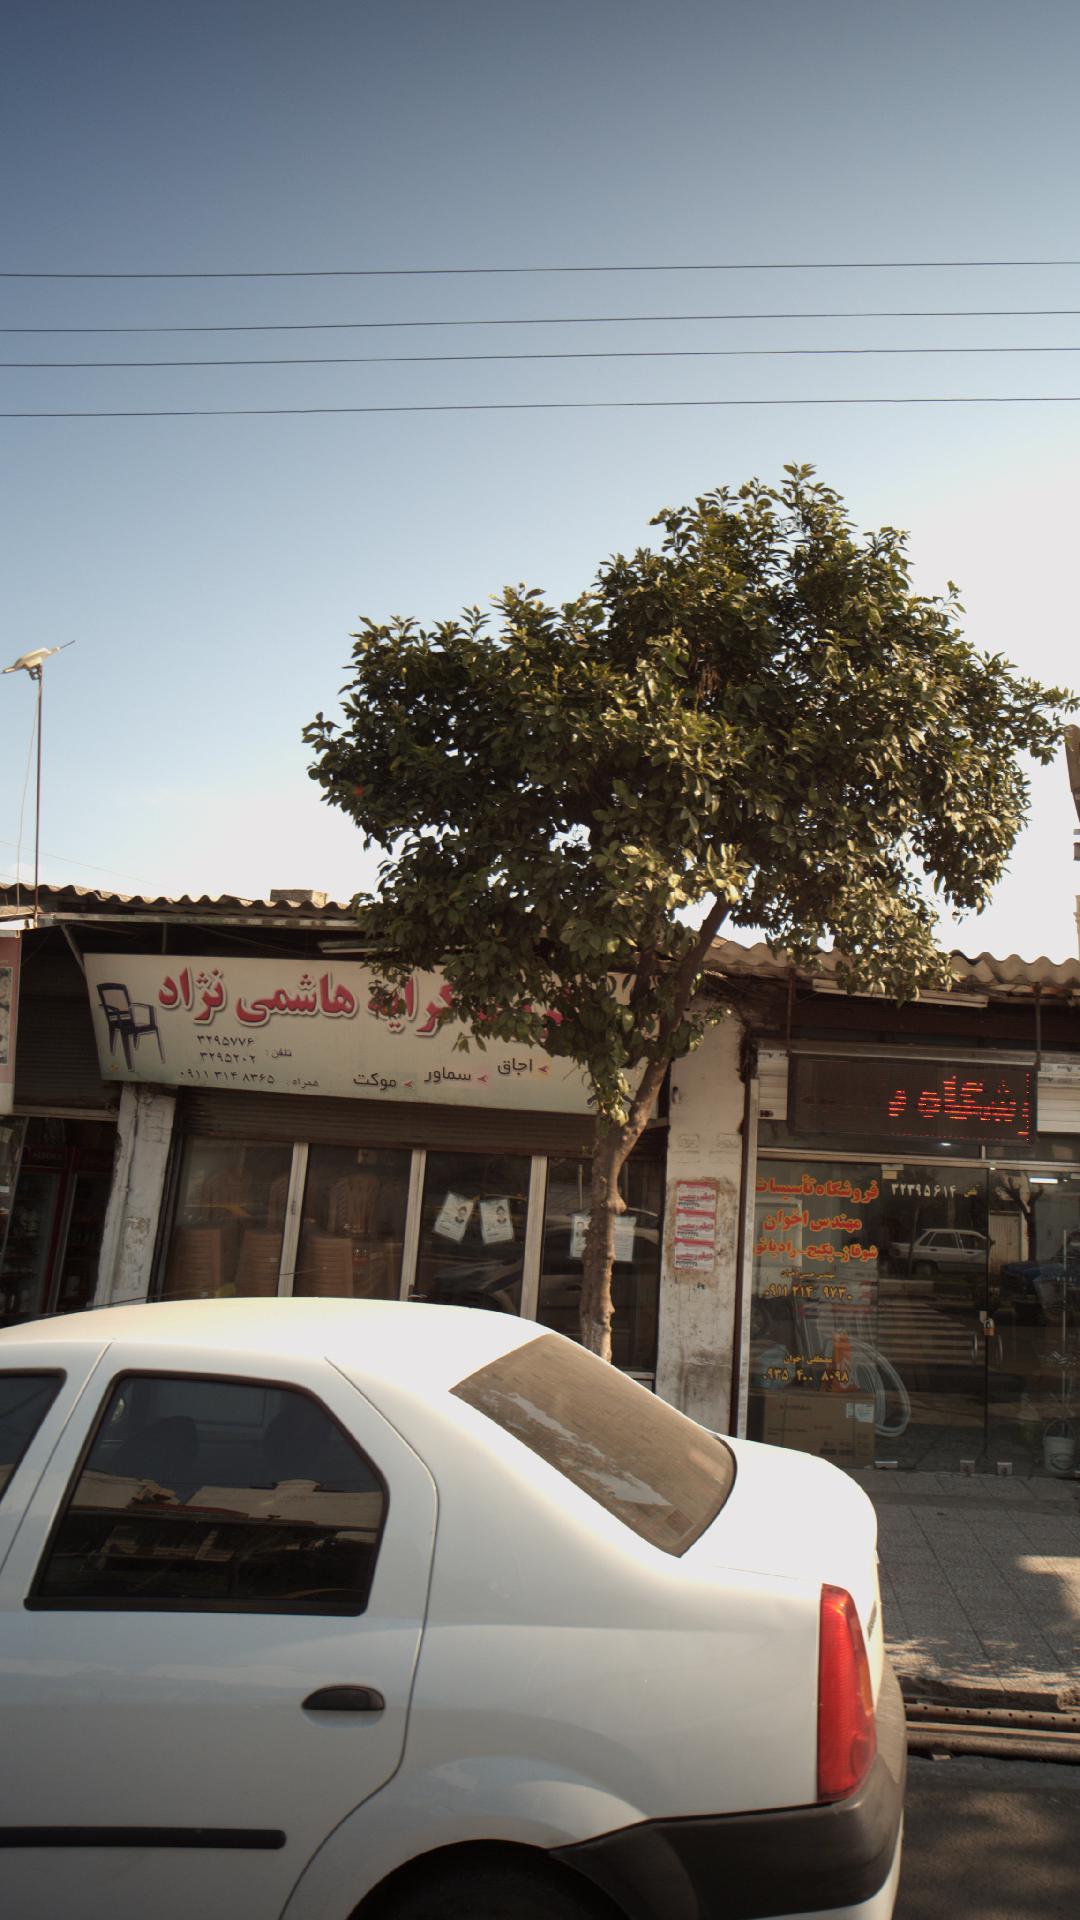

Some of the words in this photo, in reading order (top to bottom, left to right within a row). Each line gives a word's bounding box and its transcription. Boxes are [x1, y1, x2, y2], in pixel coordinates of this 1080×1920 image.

[158, 967, 226, 1023] نژاد
[235, 971, 357, 1024] هاشمی
[424, 1066, 471, 1083] سماور
[497, 1058, 533, 1076] اجاق
[353, 1072, 397, 1091] موکت
[815, 1179, 879, 1204] فروشگاه
[763, 1208, 809, 1232] اخوان
[810, 1213, 862, 1233] مهندس
